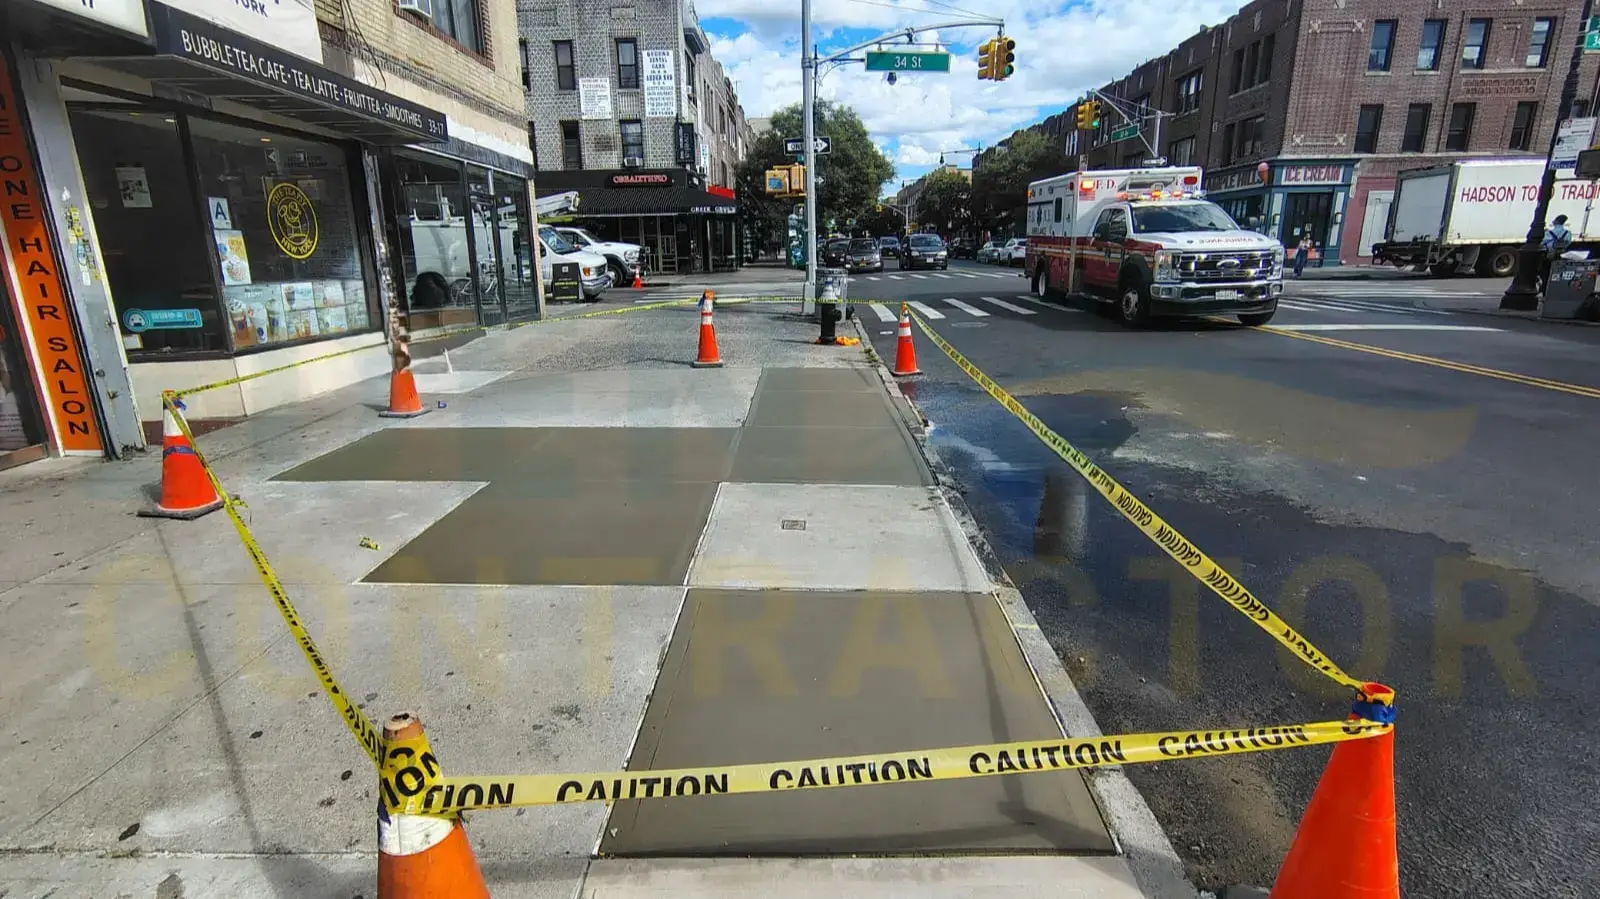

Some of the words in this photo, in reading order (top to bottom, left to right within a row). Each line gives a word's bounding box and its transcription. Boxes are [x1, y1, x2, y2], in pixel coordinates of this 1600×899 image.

[894, 56, 907, 68] 34
[911, 56, 923, 68] St
[259, 58, 287, 84] CAFE
[291, 69, 313, 93] TEA
[312, 76, 340, 101] LATTE
[385, 102, 422, 128] SMOOTHIES
[428, 118, 444, 135] 33-17
[1284, 166, 1302, 182] ICE
[1303, 165, 1340, 182] CREAM
[215, 202, 227, 221] A
[1460, 185, 1516, 203] HADSON
[1, 155, 35, 219] ONE
[19, 237, 62, 320] HAIR
[48, 337, 89, 435] SALON
[1116, 491, 1153, 527] CAUTION
[1152, 523, 1202, 568] CAUTION
[1203, 567, 1270, 622] CAUTION
[556, 773, 729, 803] CAUTION
[769, 756, 933, 790] CAUTION
[968, 739, 1127, 775] CAUTION
